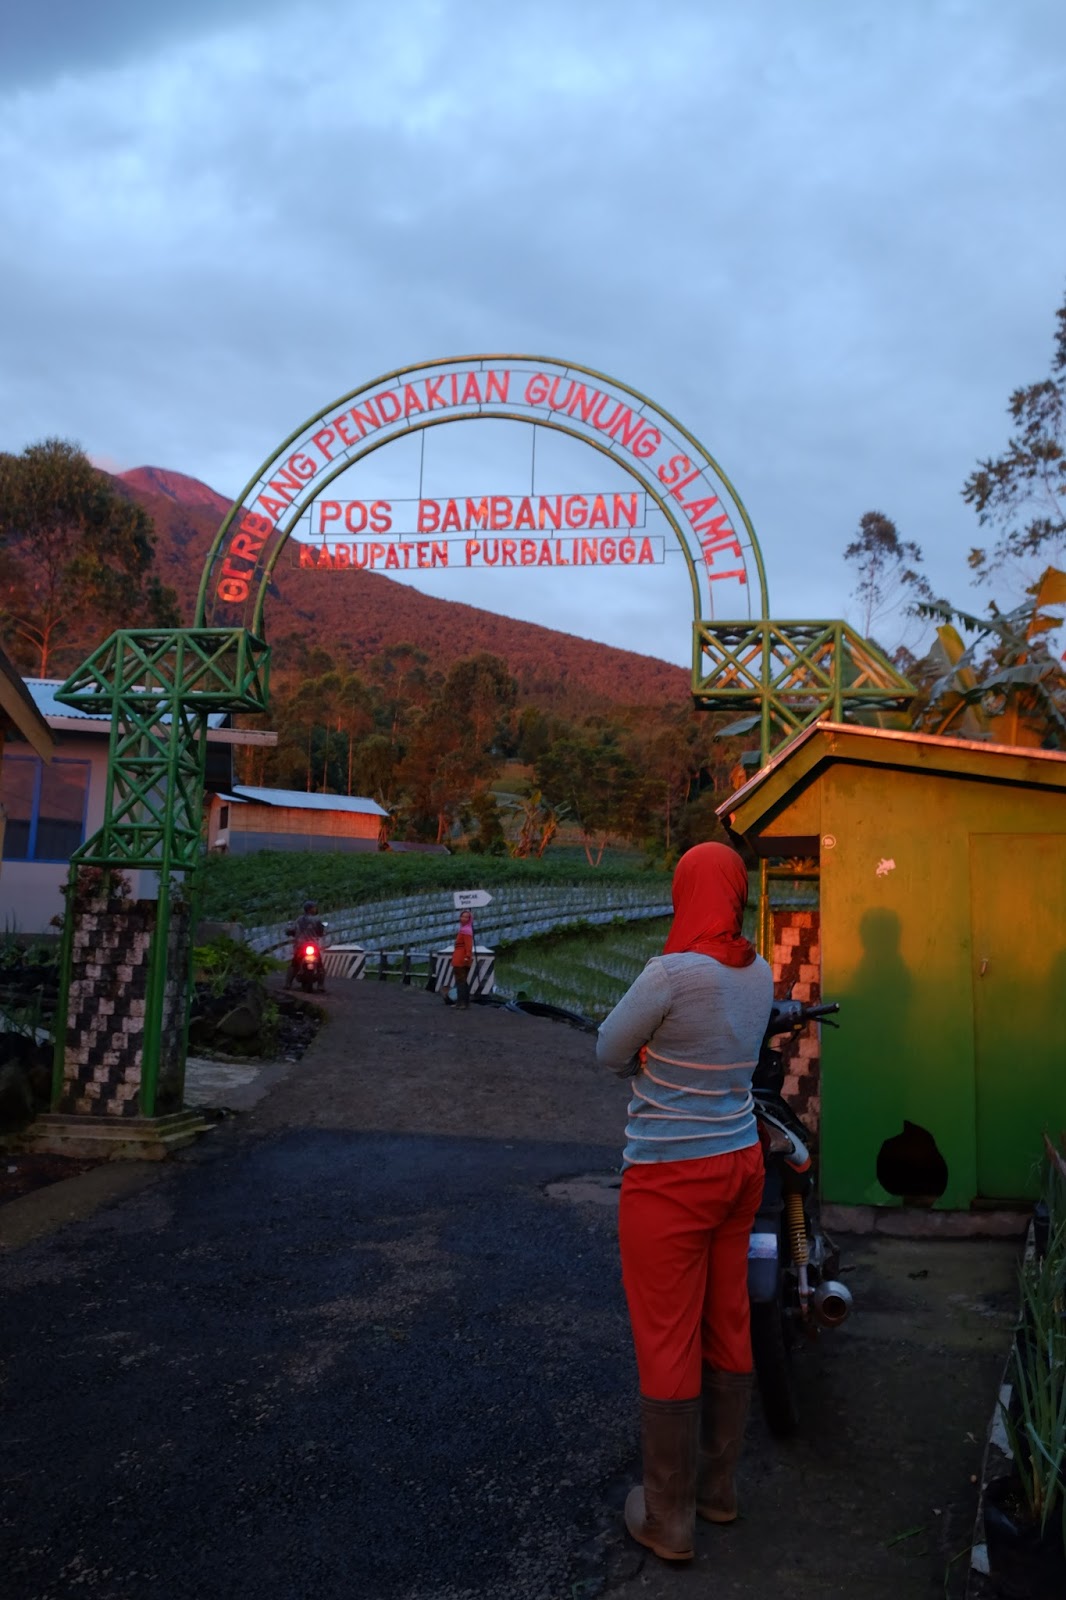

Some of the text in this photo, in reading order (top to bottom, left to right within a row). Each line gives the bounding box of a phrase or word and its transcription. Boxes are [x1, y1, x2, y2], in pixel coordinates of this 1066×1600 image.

[311, 369, 511, 463] PENDAKIAN
[524, 372, 662, 458] GUNUNG
[319, 493, 638, 534] POS BAMBANGAN
[299, 536, 655, 569] KABUPATEN PURBALINGGA
